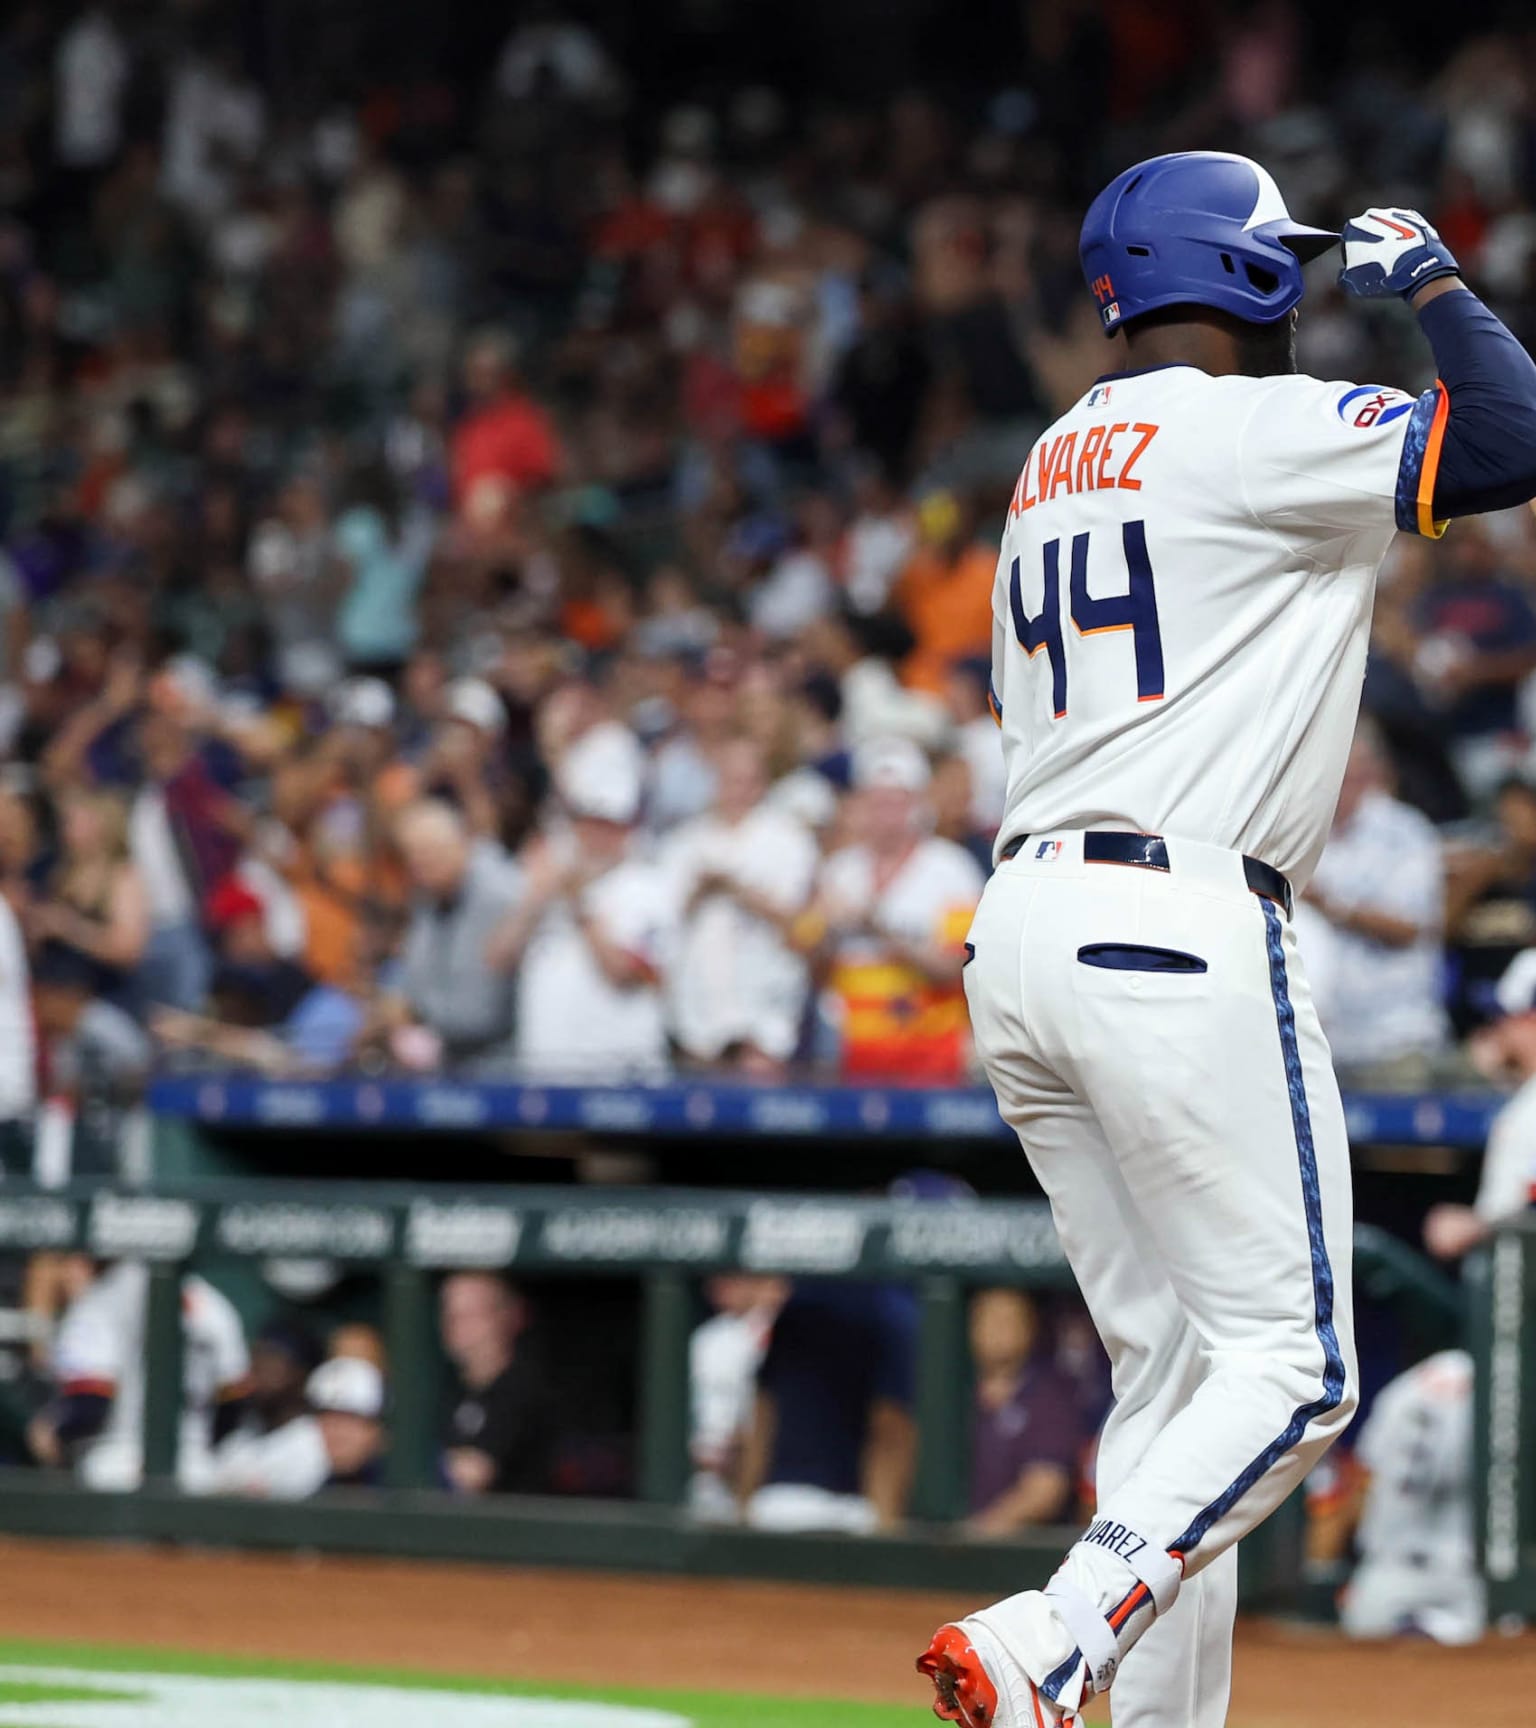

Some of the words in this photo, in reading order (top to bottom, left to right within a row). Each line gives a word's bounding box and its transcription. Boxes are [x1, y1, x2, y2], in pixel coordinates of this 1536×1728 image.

[1091, 273, 1115, 304] 44
[1010, 519, 1164, 720] 44
[1080, 1519, 1147, 1564] VAREZ
